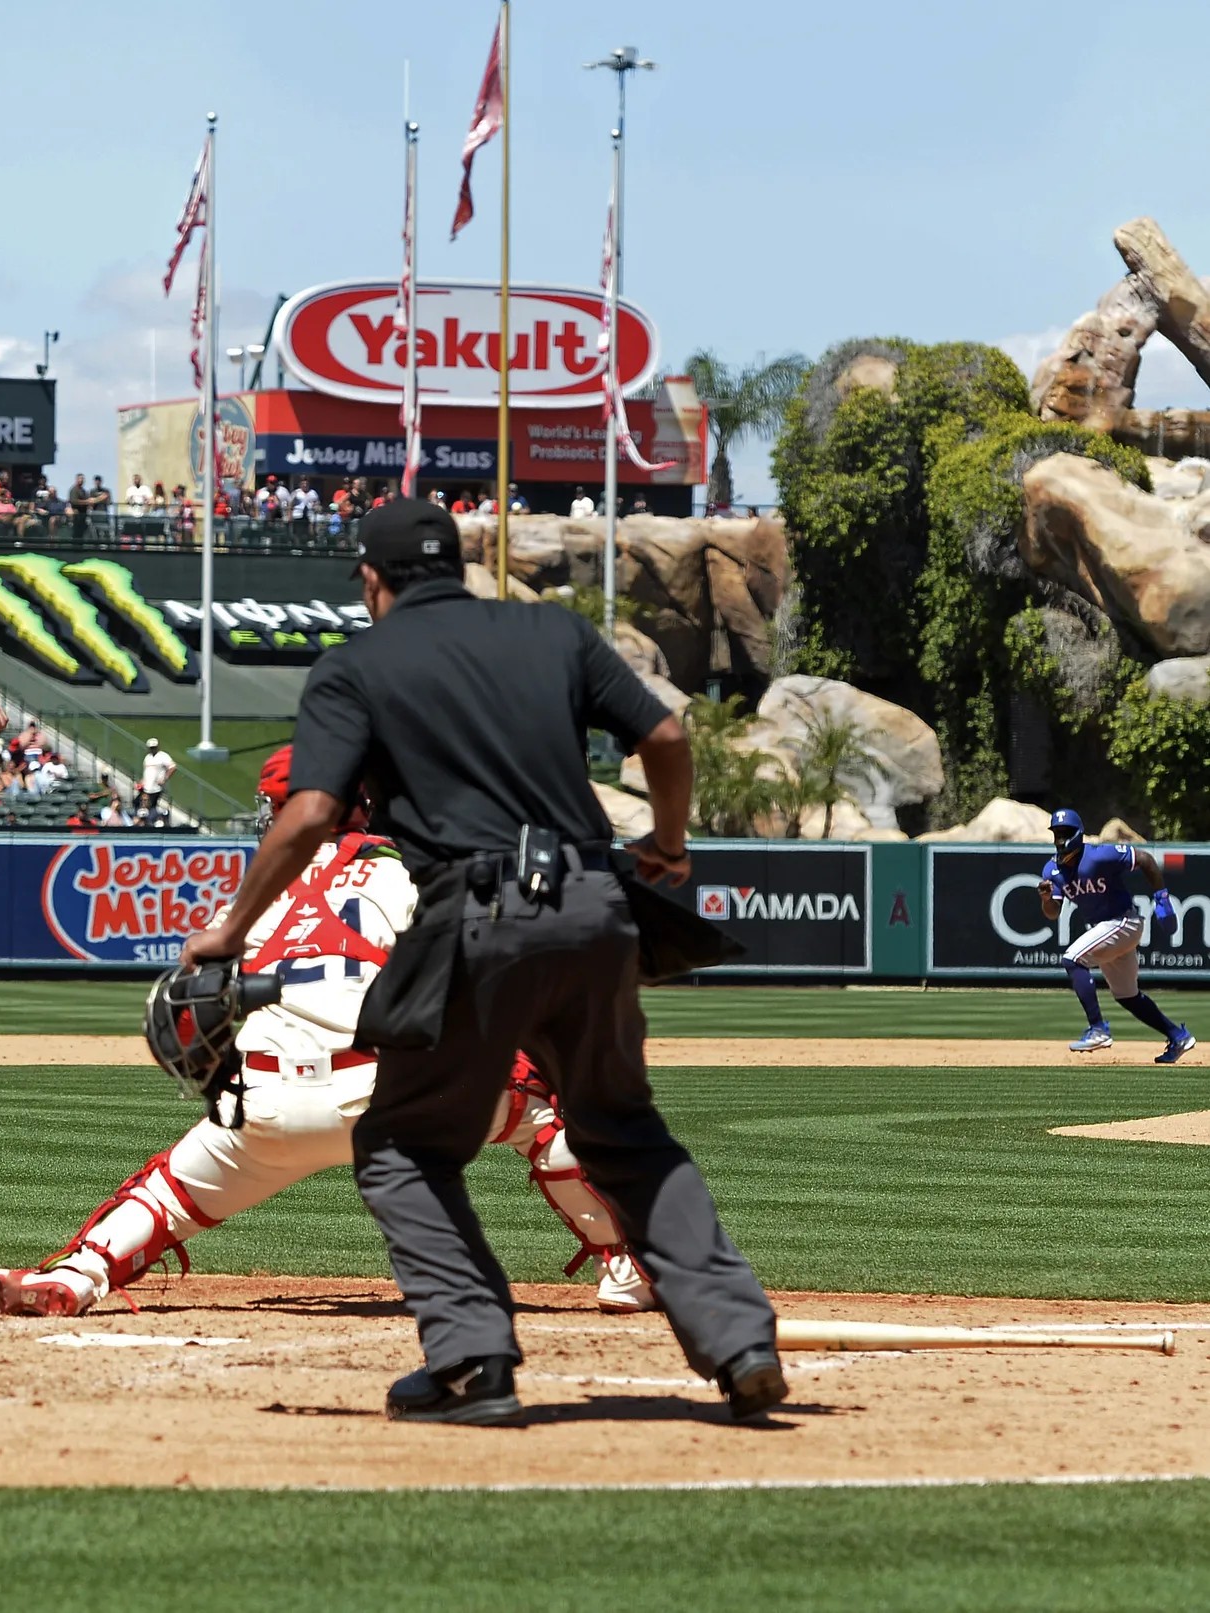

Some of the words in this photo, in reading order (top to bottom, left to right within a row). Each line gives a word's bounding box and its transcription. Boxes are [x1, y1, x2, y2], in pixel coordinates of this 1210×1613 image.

[348, 313, 599, 376] Yakult
[528, 424, 580, 439] World's
[583, 424, 643, 444] Leag
[286, 439, 360, 473] Jersey
[530, 443, 597, 460] Probiotic
[78, 845, 244, 894] Jersey
[1062, 876, 1107, 900] EXAS
[729, 886, 861, 921] YAMADA
[132, 942, 182, 962] SUB
[1150, 952, 1204, 967] Frozen
